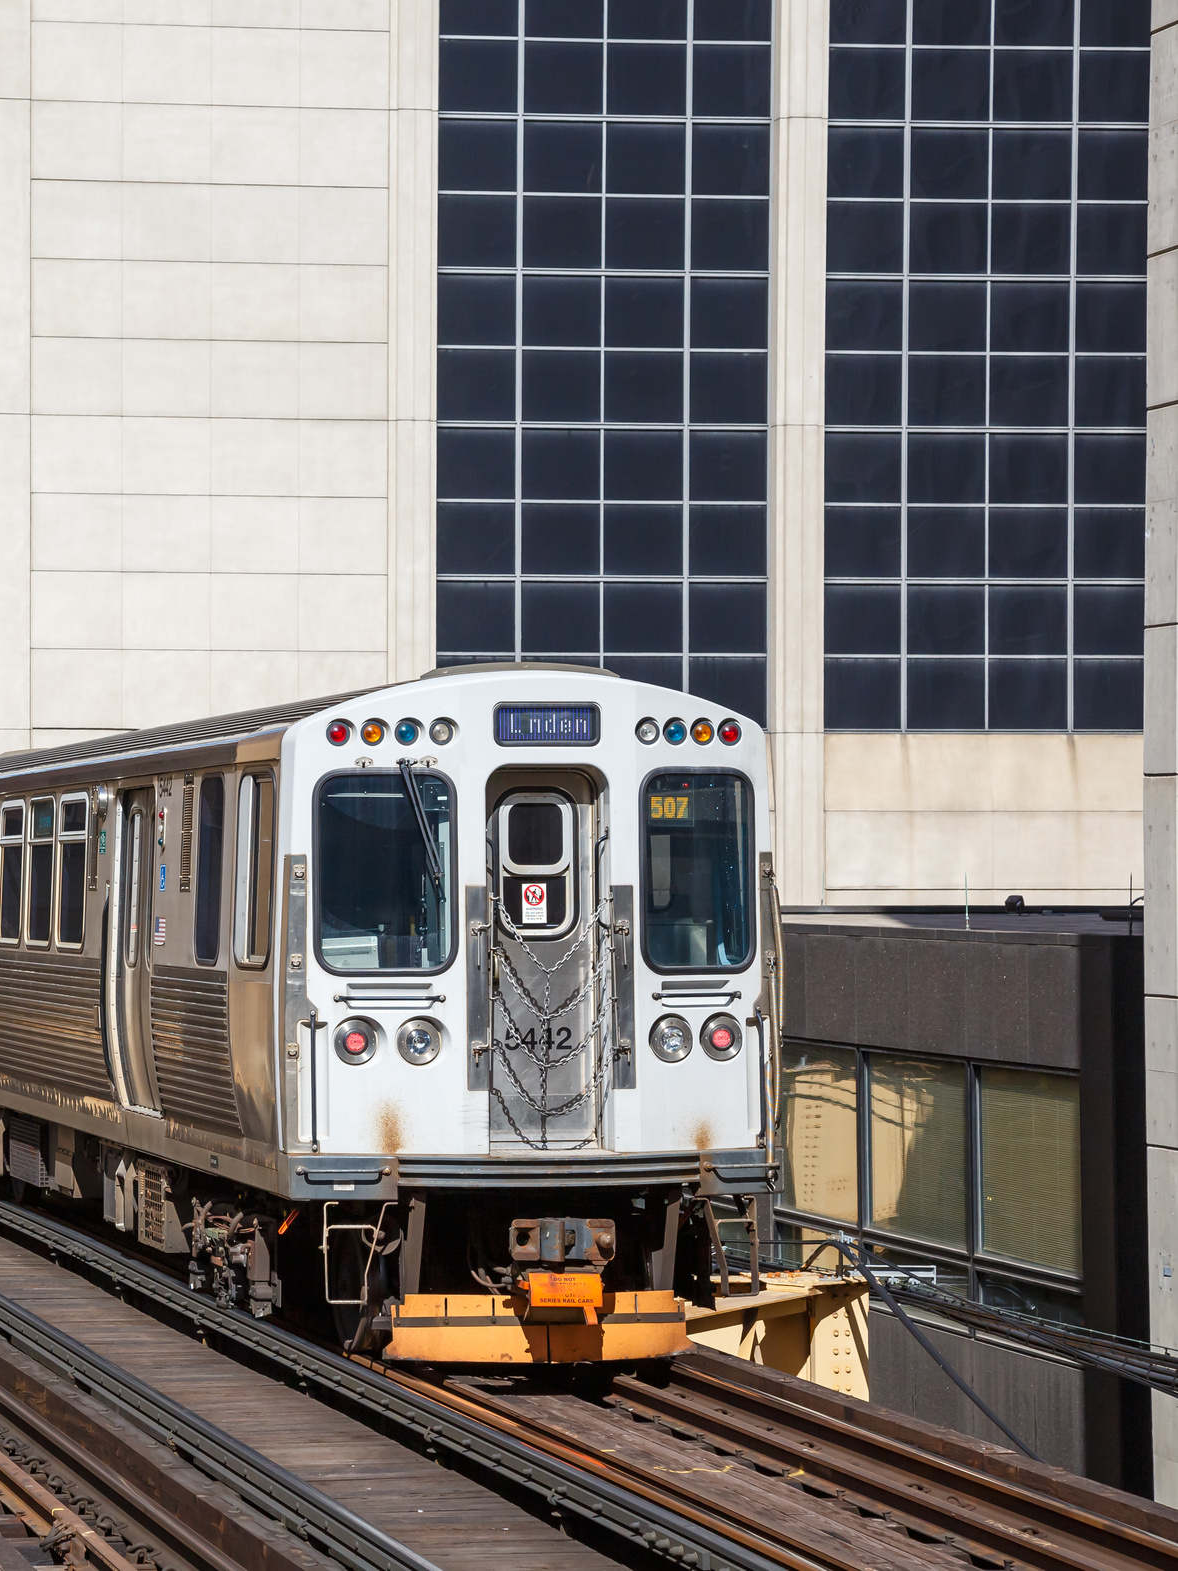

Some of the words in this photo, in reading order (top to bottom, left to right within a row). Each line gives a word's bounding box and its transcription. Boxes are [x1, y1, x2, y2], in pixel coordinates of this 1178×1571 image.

[510, 713, 587, 734] Lnden
[651, 796, 689, 819] 507
[504, 1026, 572, 1050] 5442
